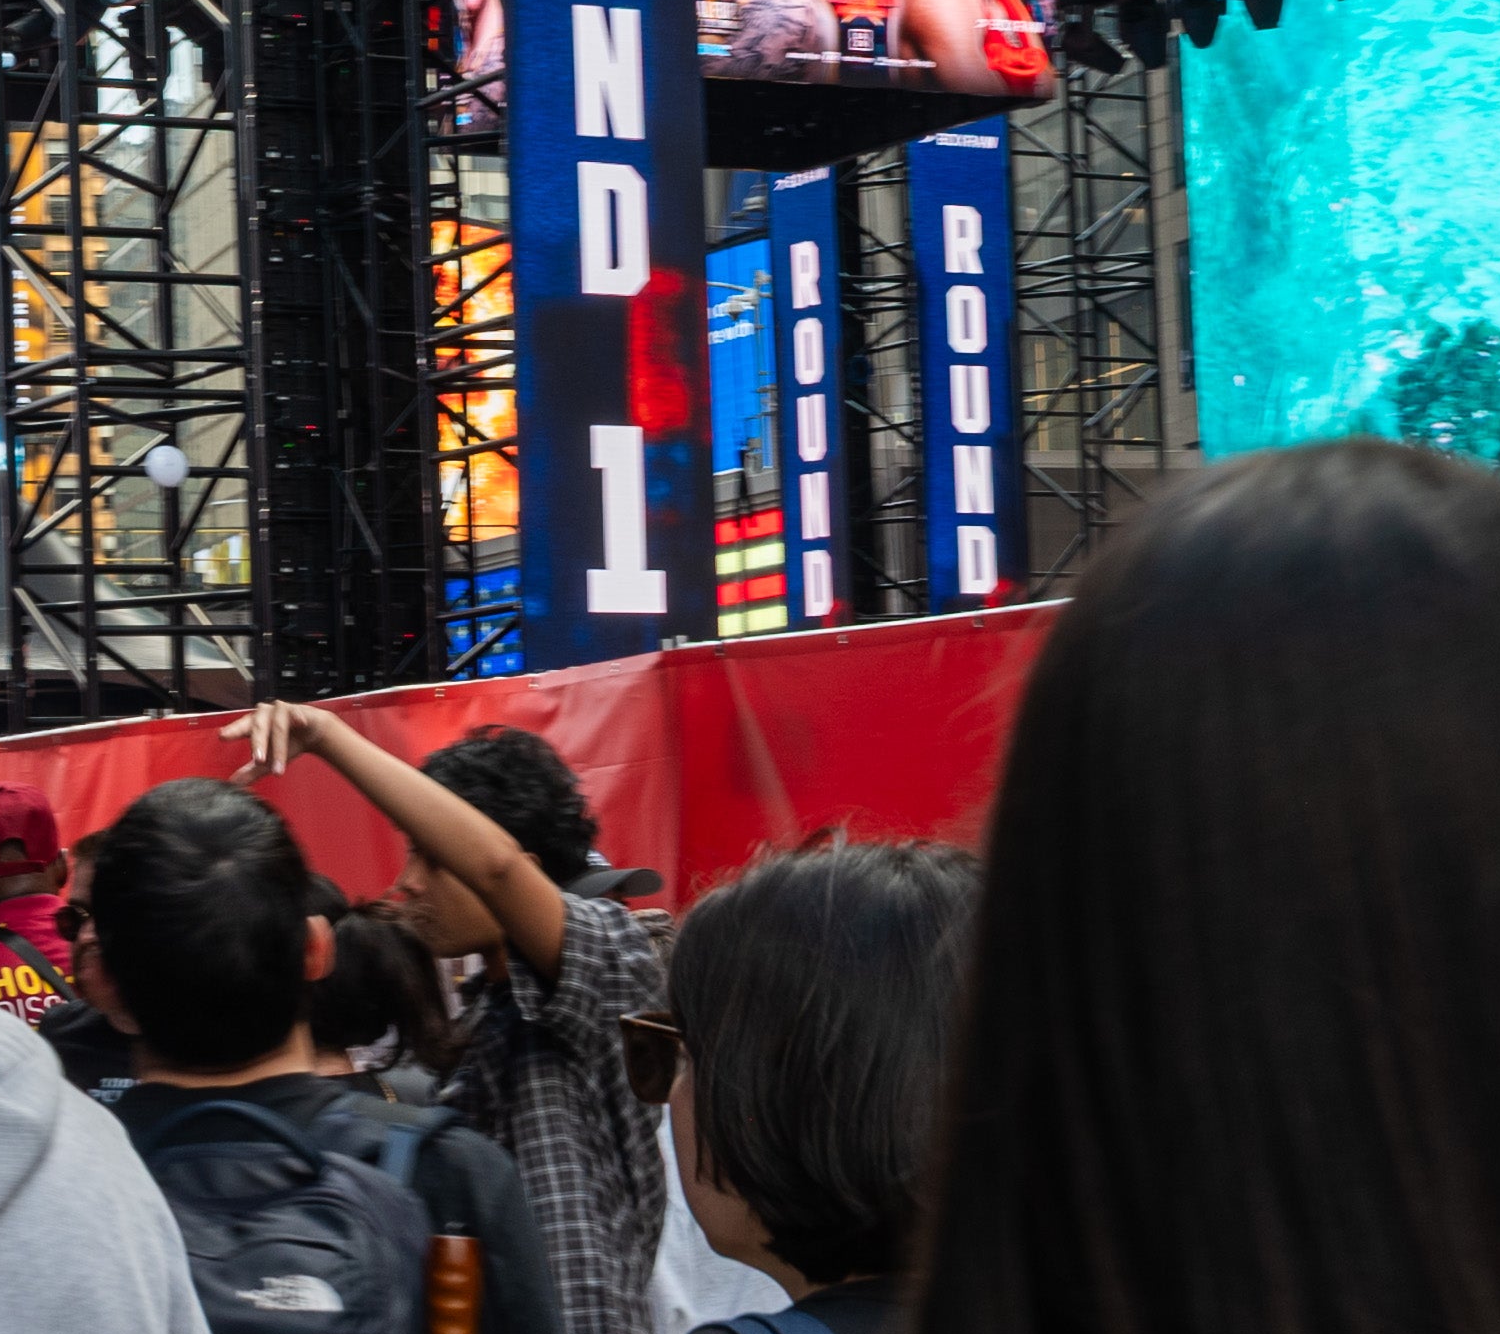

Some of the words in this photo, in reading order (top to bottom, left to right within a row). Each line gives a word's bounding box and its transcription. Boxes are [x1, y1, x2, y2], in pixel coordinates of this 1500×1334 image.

[586, 424, 668, 614] 1
[789, 240, 834, 618] ROUND
[941, 203, 999, 596] ROUND
